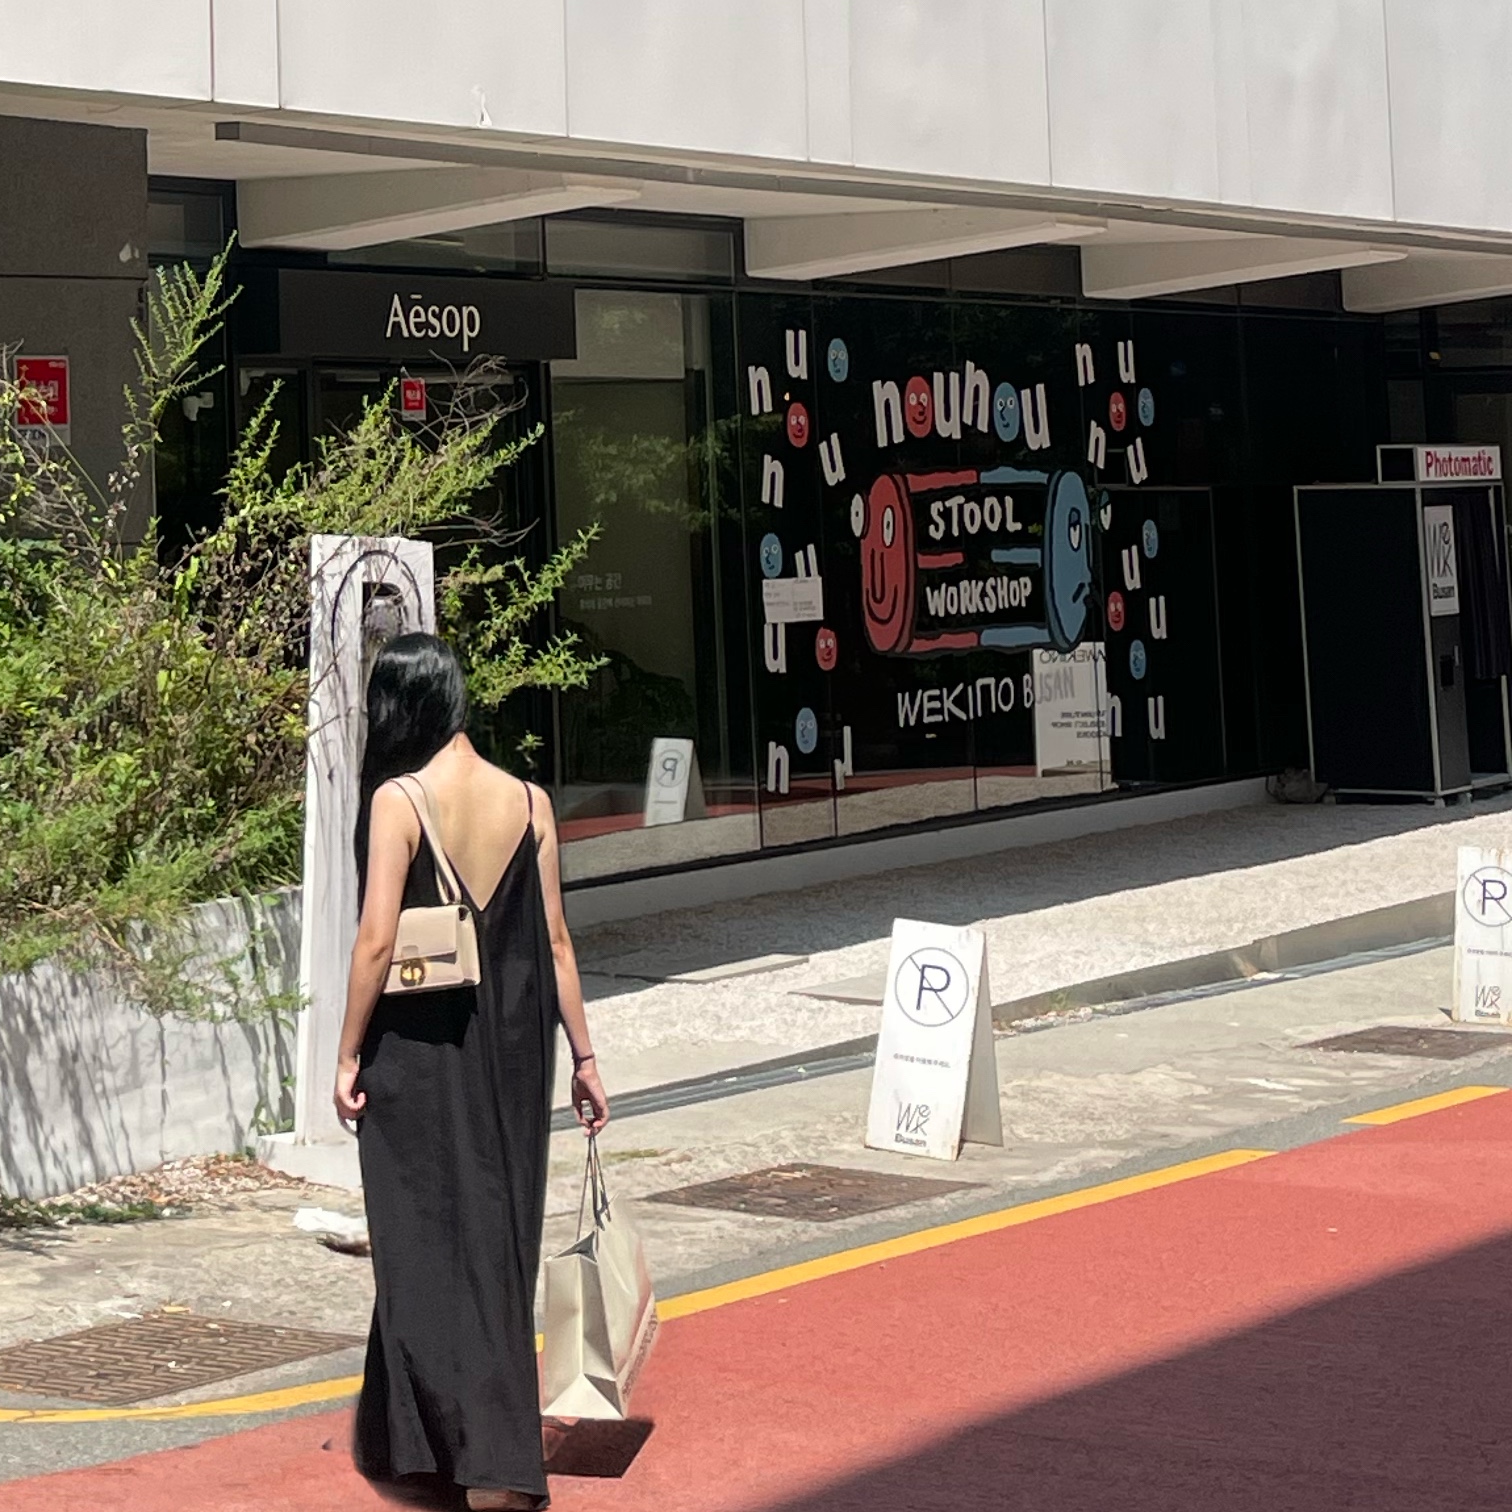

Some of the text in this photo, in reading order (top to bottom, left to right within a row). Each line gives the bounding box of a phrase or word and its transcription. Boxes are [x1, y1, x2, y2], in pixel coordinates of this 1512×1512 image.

[1425, 449, 1494, 477] Photomatic
[928, 495, 1022, 540] STOOL
[925, 575, 1032, 618] WORKSHOP
[894, 1133, 927, 1148] Busan
